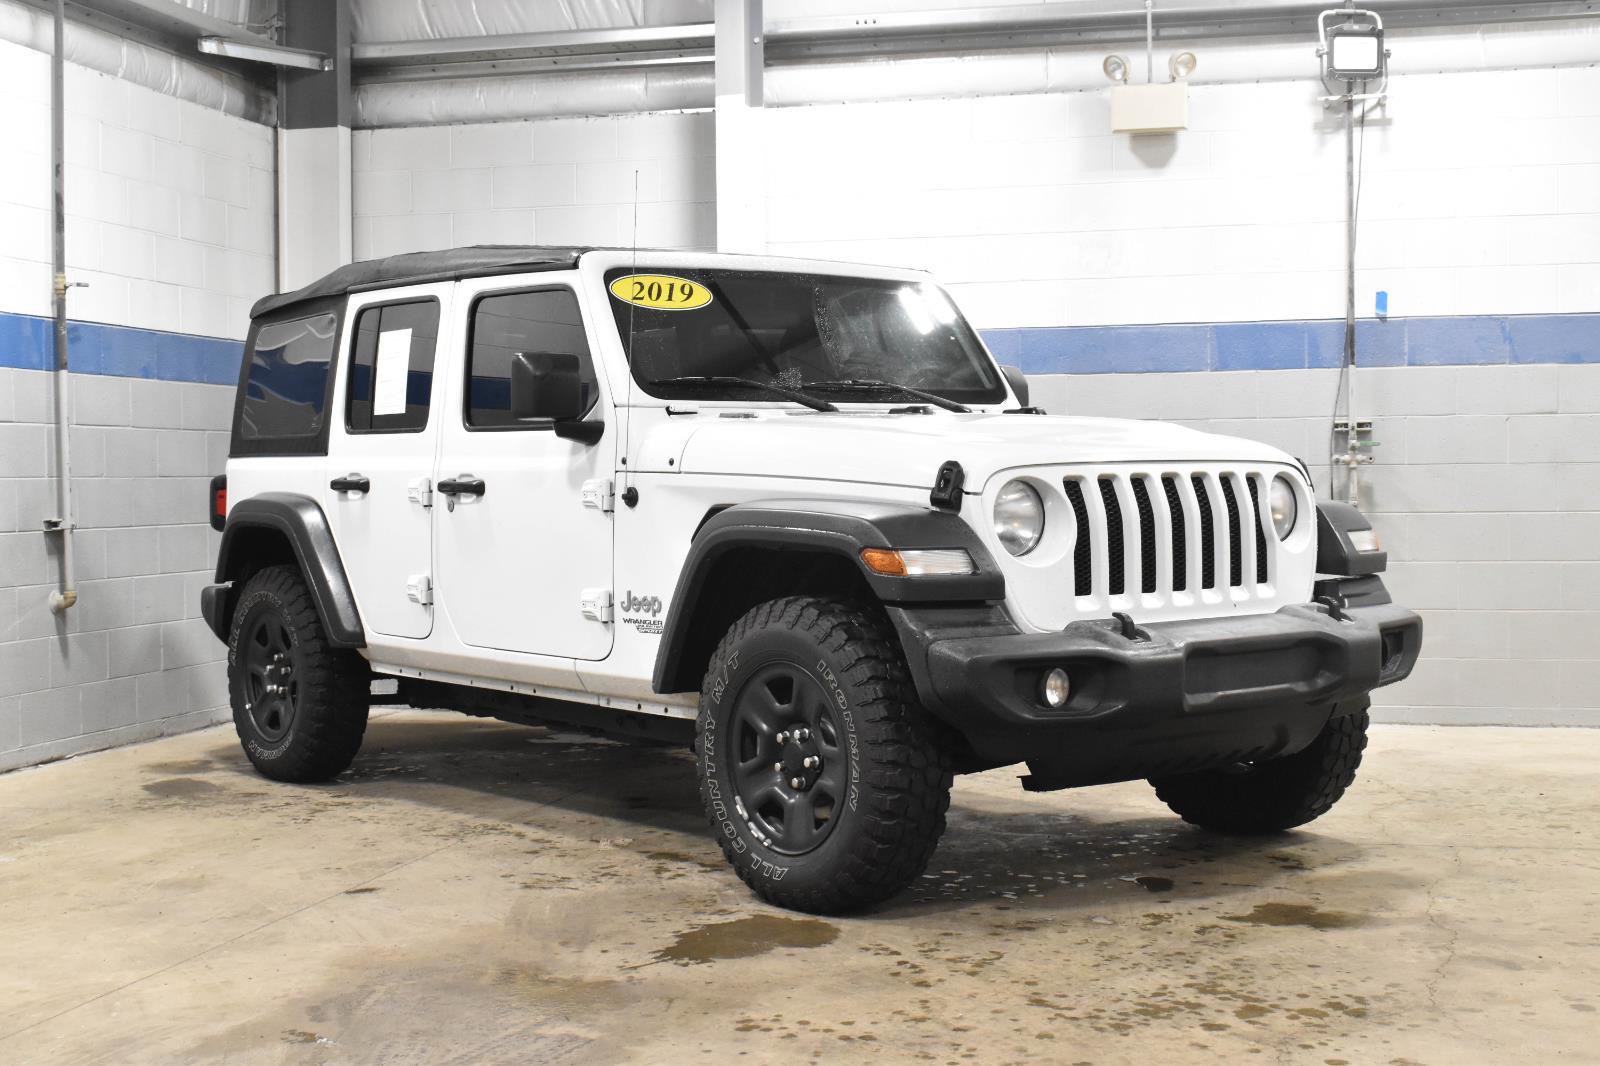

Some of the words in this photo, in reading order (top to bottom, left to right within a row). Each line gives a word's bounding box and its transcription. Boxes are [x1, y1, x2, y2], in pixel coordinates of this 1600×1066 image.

[631, 281, 694, 302] 2019
[621, 590, 662, 617] Jeep
[623, 617, 663, 625] WRANGLER
[711, 650, 739, 704] M/T
[817, 659, 860, 812] IRONMAN
[704, 709, 747, 854] COUNTRY
[751, 852, 789, 881] ALL
